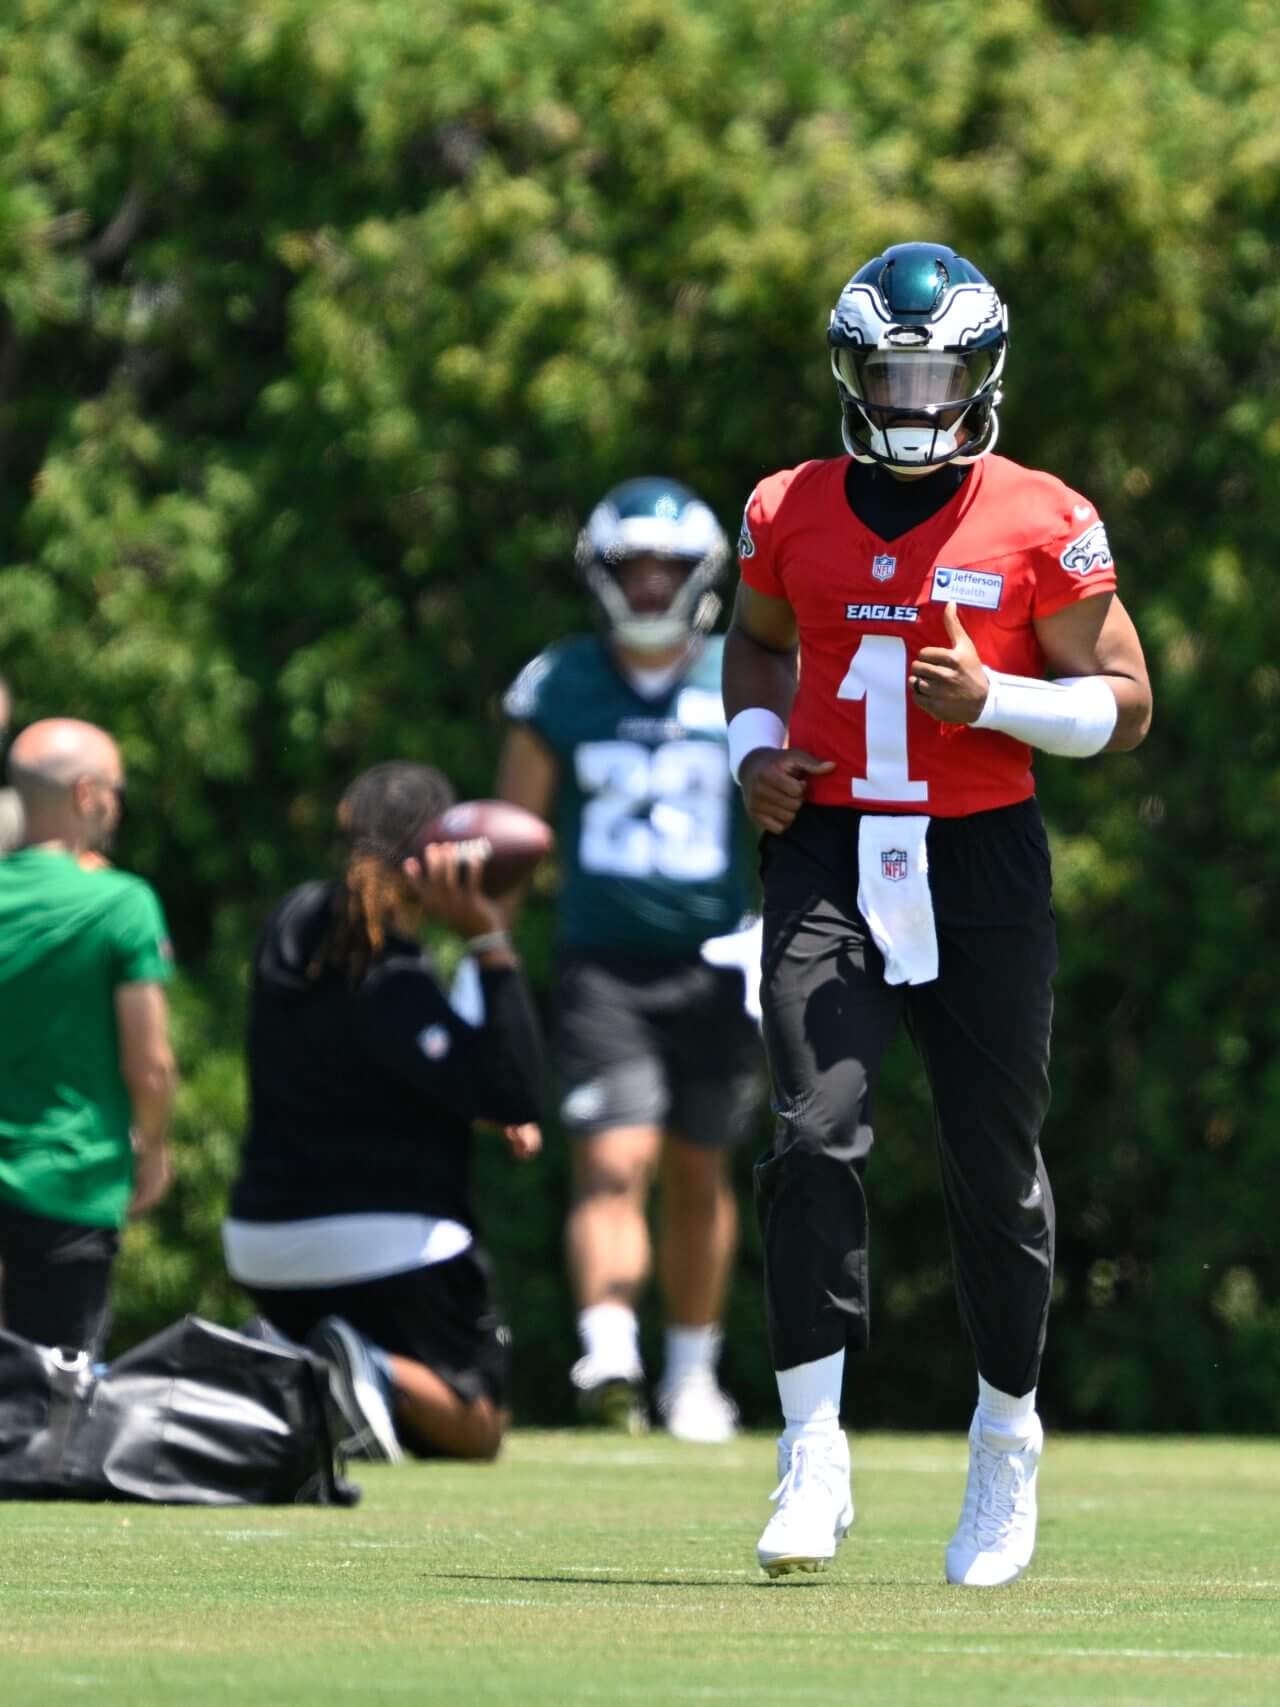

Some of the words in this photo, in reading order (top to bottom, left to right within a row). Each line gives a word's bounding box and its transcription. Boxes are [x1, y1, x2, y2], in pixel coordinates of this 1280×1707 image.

[953, 571, 1001, 588] Jefferson
[846, 604, 918, 622] EAGLES
[837, 634, 928, 802] 1
[884, 861, 905, 879] NFL
